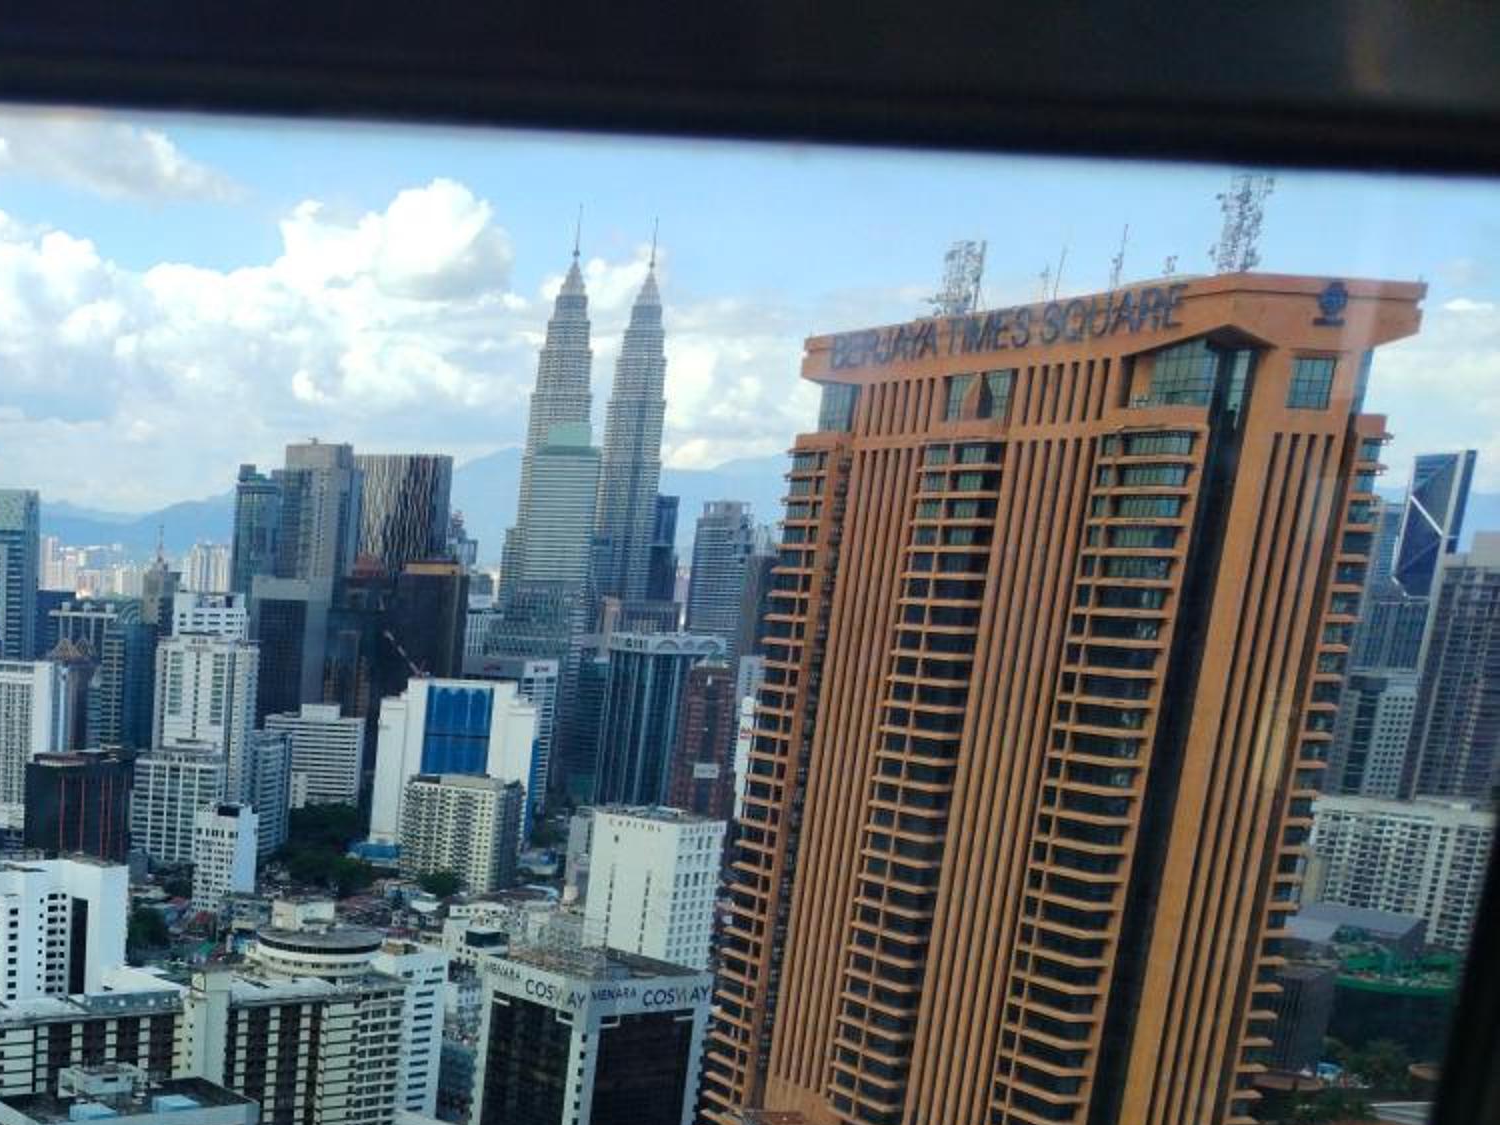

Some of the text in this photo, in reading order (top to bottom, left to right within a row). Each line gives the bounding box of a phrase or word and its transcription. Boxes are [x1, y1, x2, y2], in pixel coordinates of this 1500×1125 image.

[830, 283, 1190, 369] BERJAYA TIMES SQUARE
[591, 986, 638, 1001] MENARA
